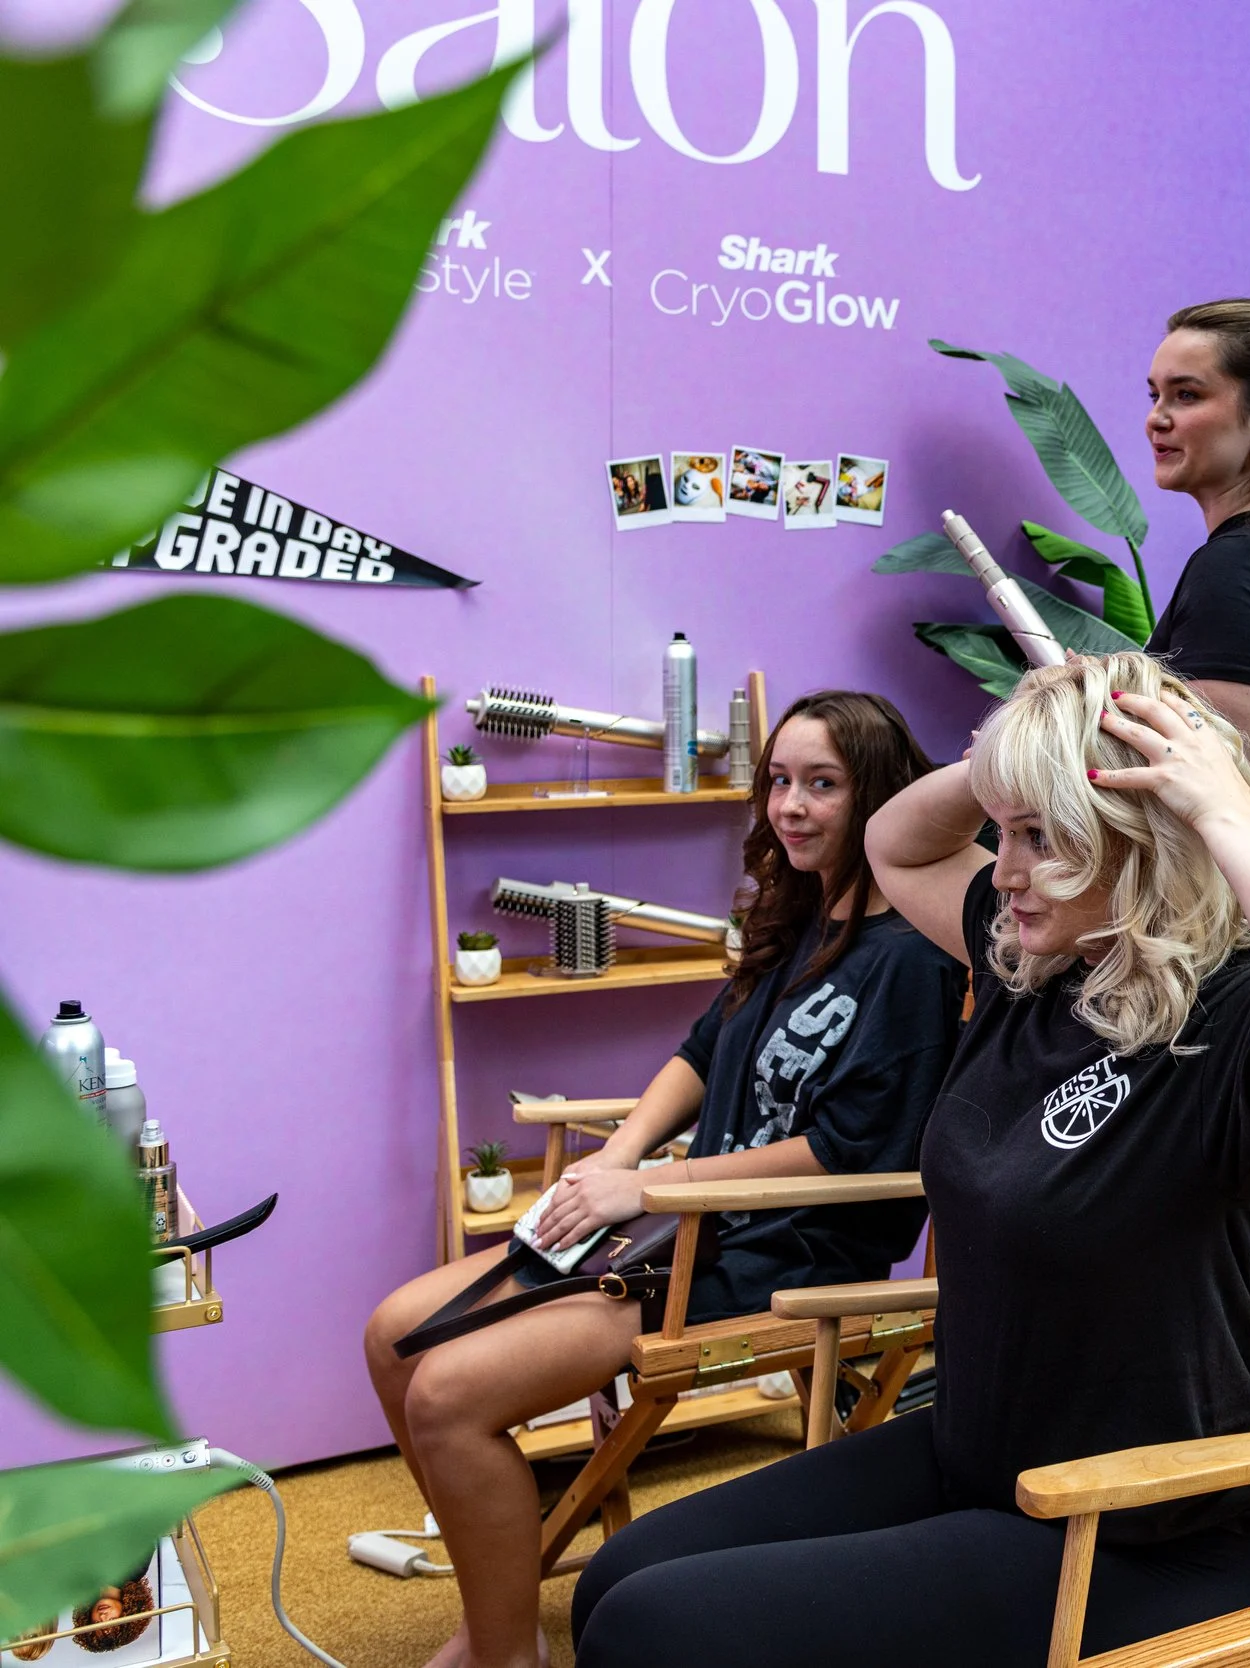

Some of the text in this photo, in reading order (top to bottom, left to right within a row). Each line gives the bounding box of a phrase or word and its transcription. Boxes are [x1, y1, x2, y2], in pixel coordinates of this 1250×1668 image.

[413, 252, 533, 303] Style
[717, 234, 839, 277] Shark
[650, 269, 900, 330] CryoGlow
[112, 512, 395, 583] GRADED
[300, 509, 393, 560] DAY
[78, 1075, 105, 1092] KEN
[1043, 1052, 1117, 1117] ZEST
